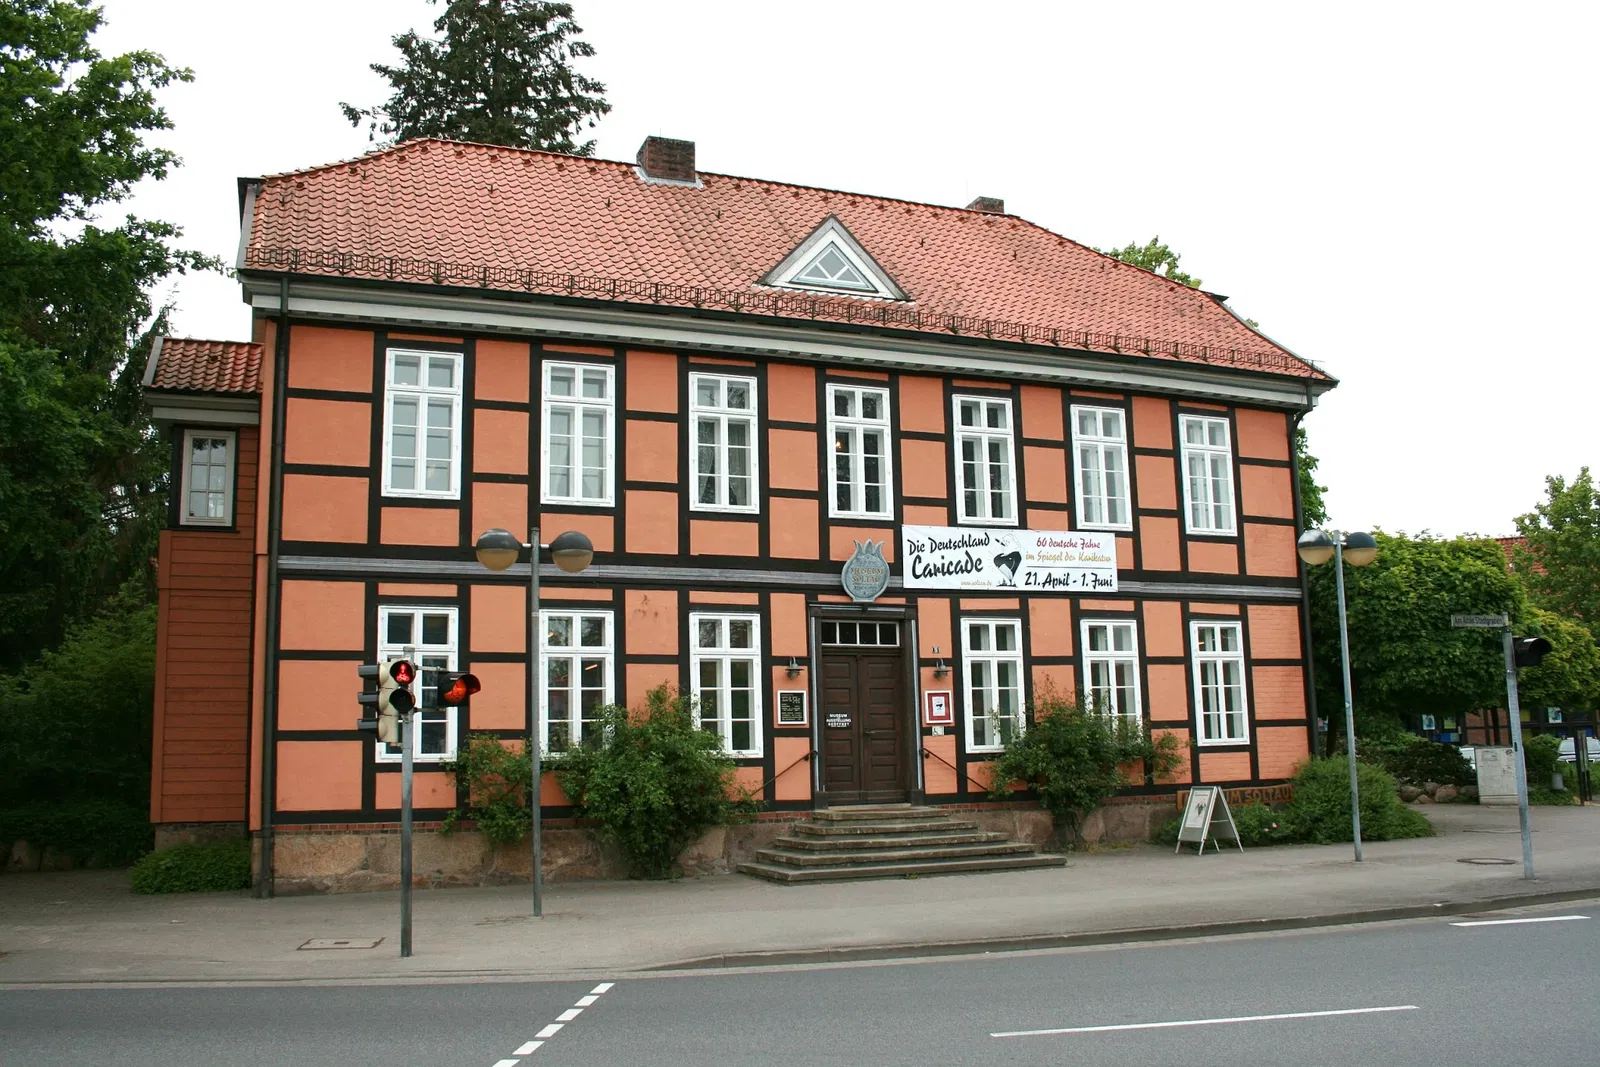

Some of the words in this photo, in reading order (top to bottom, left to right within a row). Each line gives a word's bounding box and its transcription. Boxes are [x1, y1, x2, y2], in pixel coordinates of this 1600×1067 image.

[907, 539, 925, 556] Die
[928, 532, 990, 554] Deutschland
[1036, 537, 1047, 547] 60
[1048, 537, 1078, 548] deutsche
[1080, 537, 1101, 550] Jahre
[1025, 550, 1035, 560] im
[1037, 550, 1063, 563] Spiegel
[1064, 551, 1076, 561] der
[1078, 551, 1112, 562] Karikatur
[850, 567, 884, 575] MUSEUM
[912, 550, 983, 580] Caricade
[852, 575, 880, 583] SOLTAU
[1024, 571, 1041, 586] 21.
[1041, 572, 1070, 588] April
[1081, 572, 1089, 587] 1.
[1090, 572, 1113, 589] Juni
[1244, 787, 1290, 802] SOLTAU
